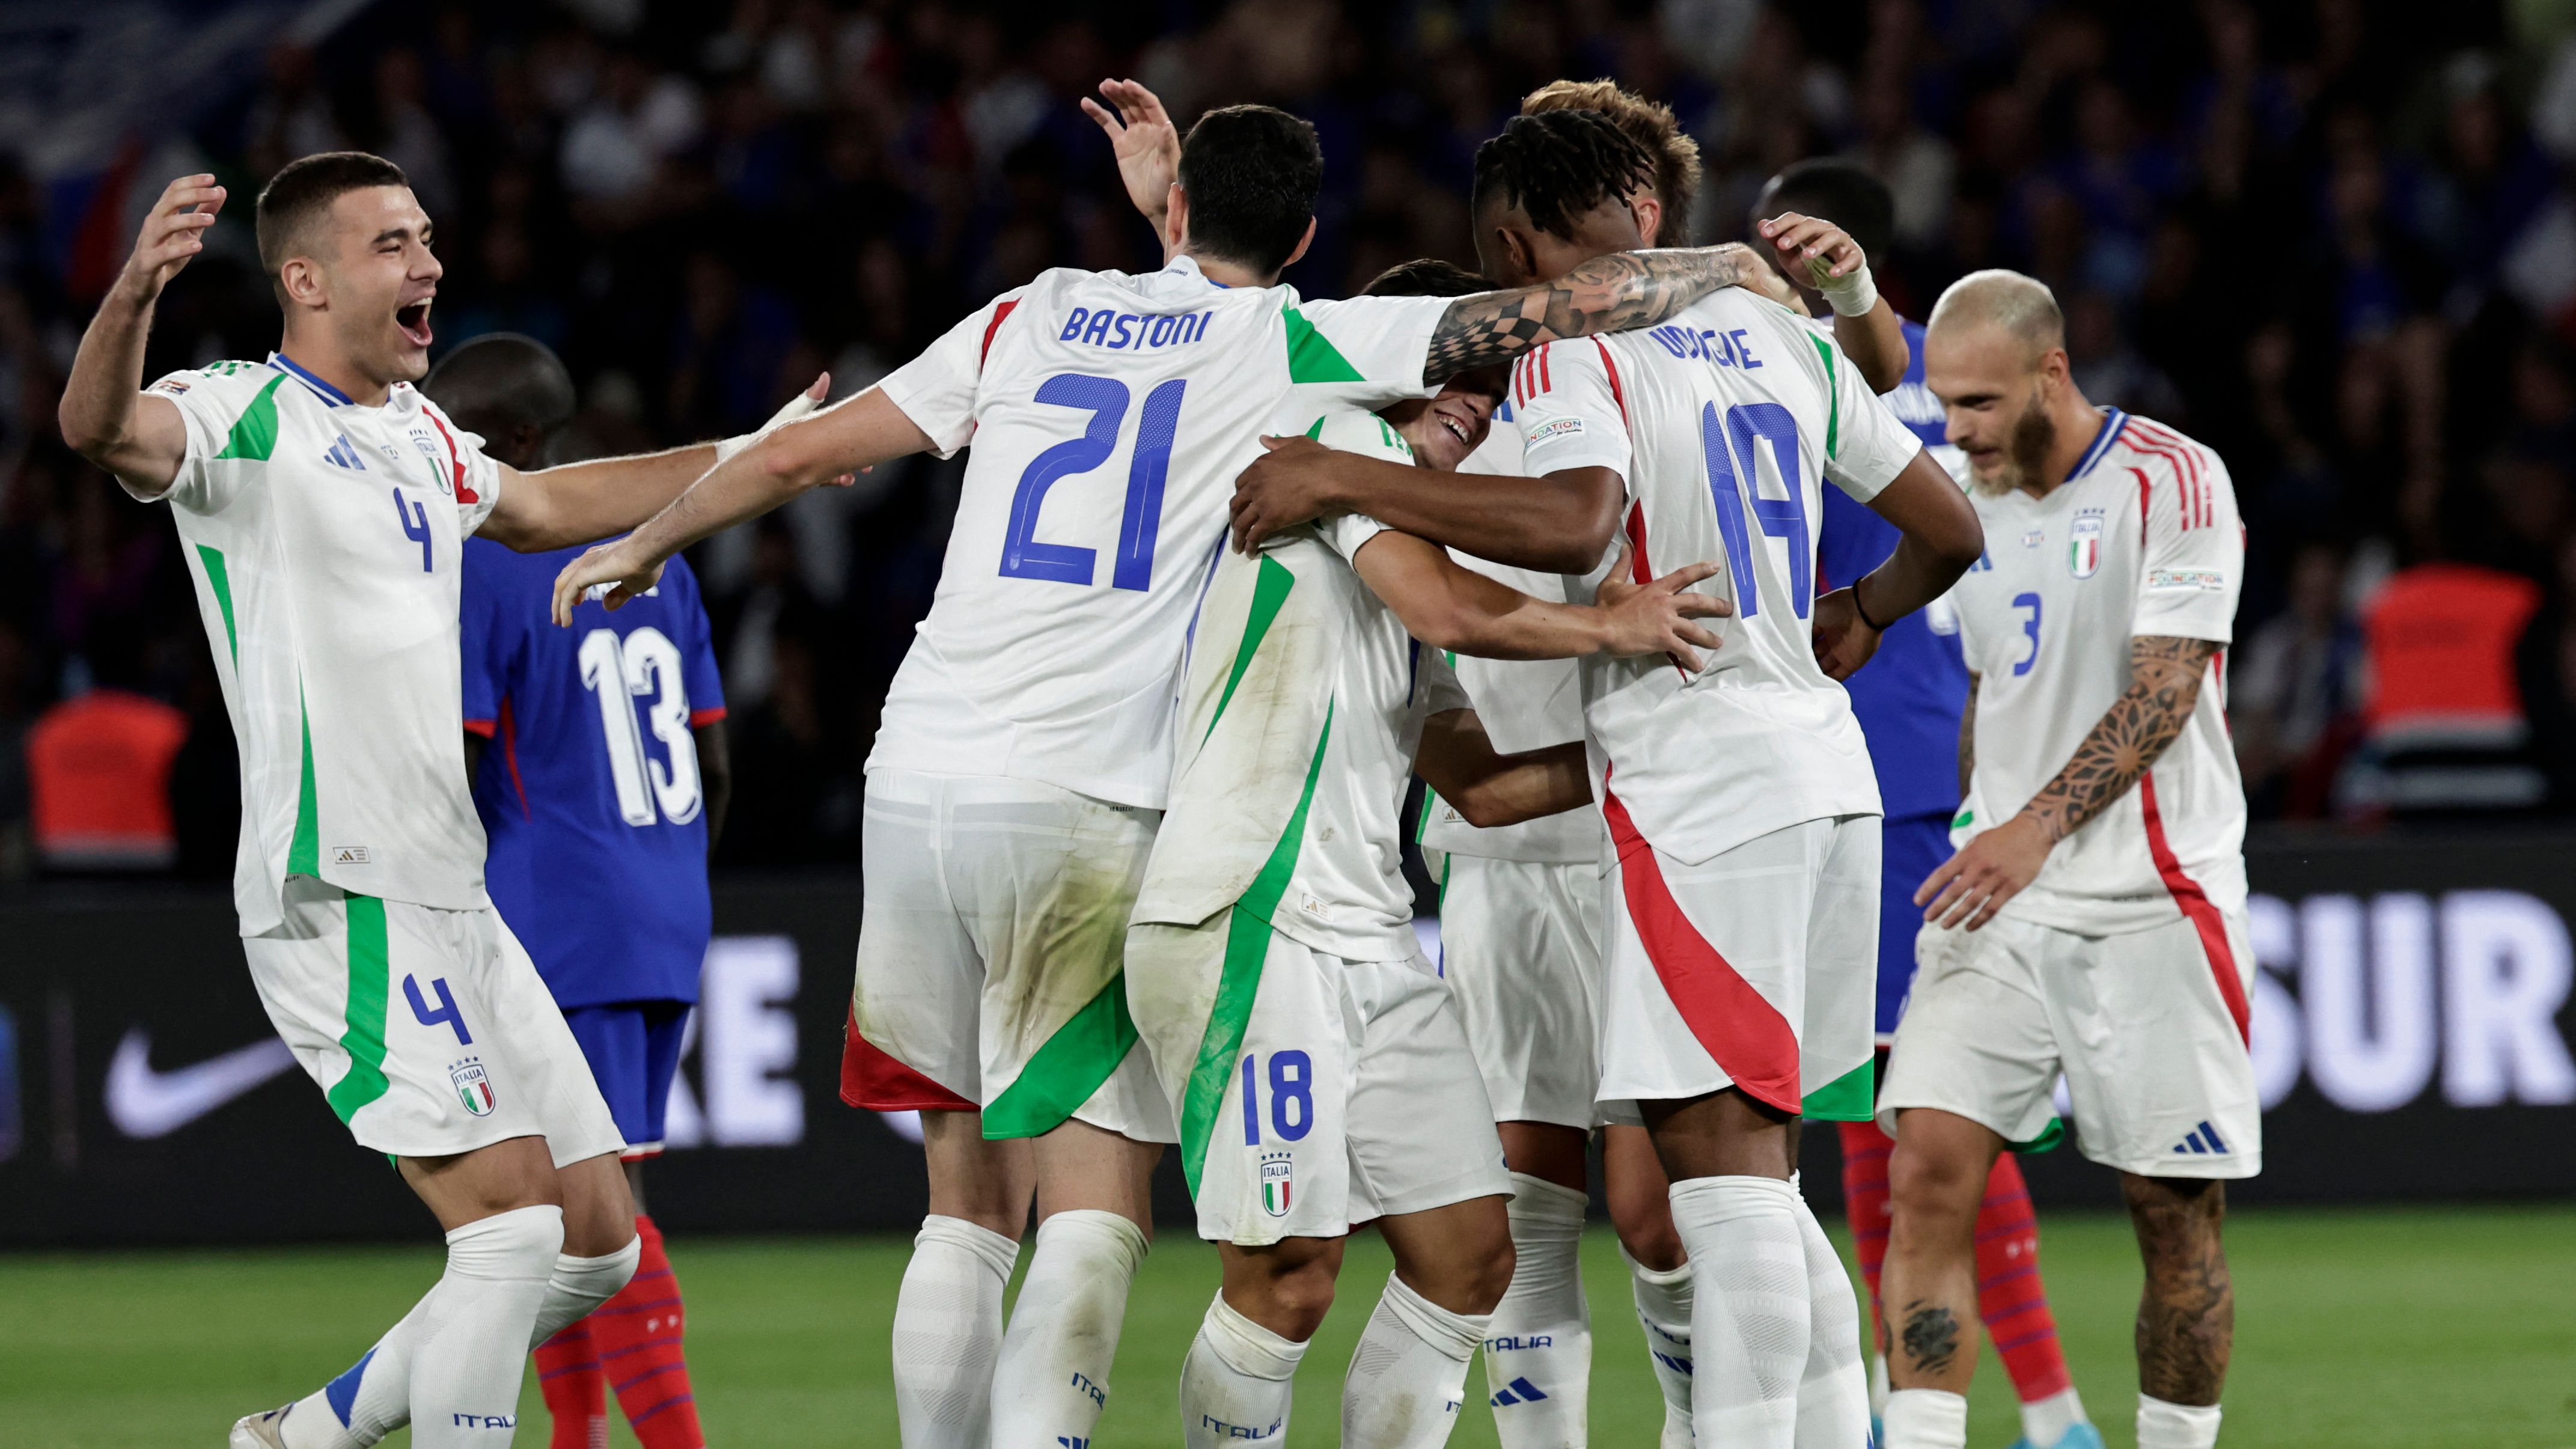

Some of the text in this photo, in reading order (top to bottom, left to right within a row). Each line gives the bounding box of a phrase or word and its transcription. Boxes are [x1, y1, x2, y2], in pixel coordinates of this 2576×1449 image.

[1059, 307, 1213, 350] BASTONI
[998, 373, 1187, 592] 21
[1702, 400, 1811, 620] 19
[394, 487, 432, 573] 4
[2012, 591, 2042, 677] 3
[578, 626, 703, 826] 13
[403, 973, 473, 1046] 4
[454, 1068, 483, 1085] ITALIA
[1242, 1050, 1313, 1146] 18
[1263, 1165, 1289, 1177] ITALIA
